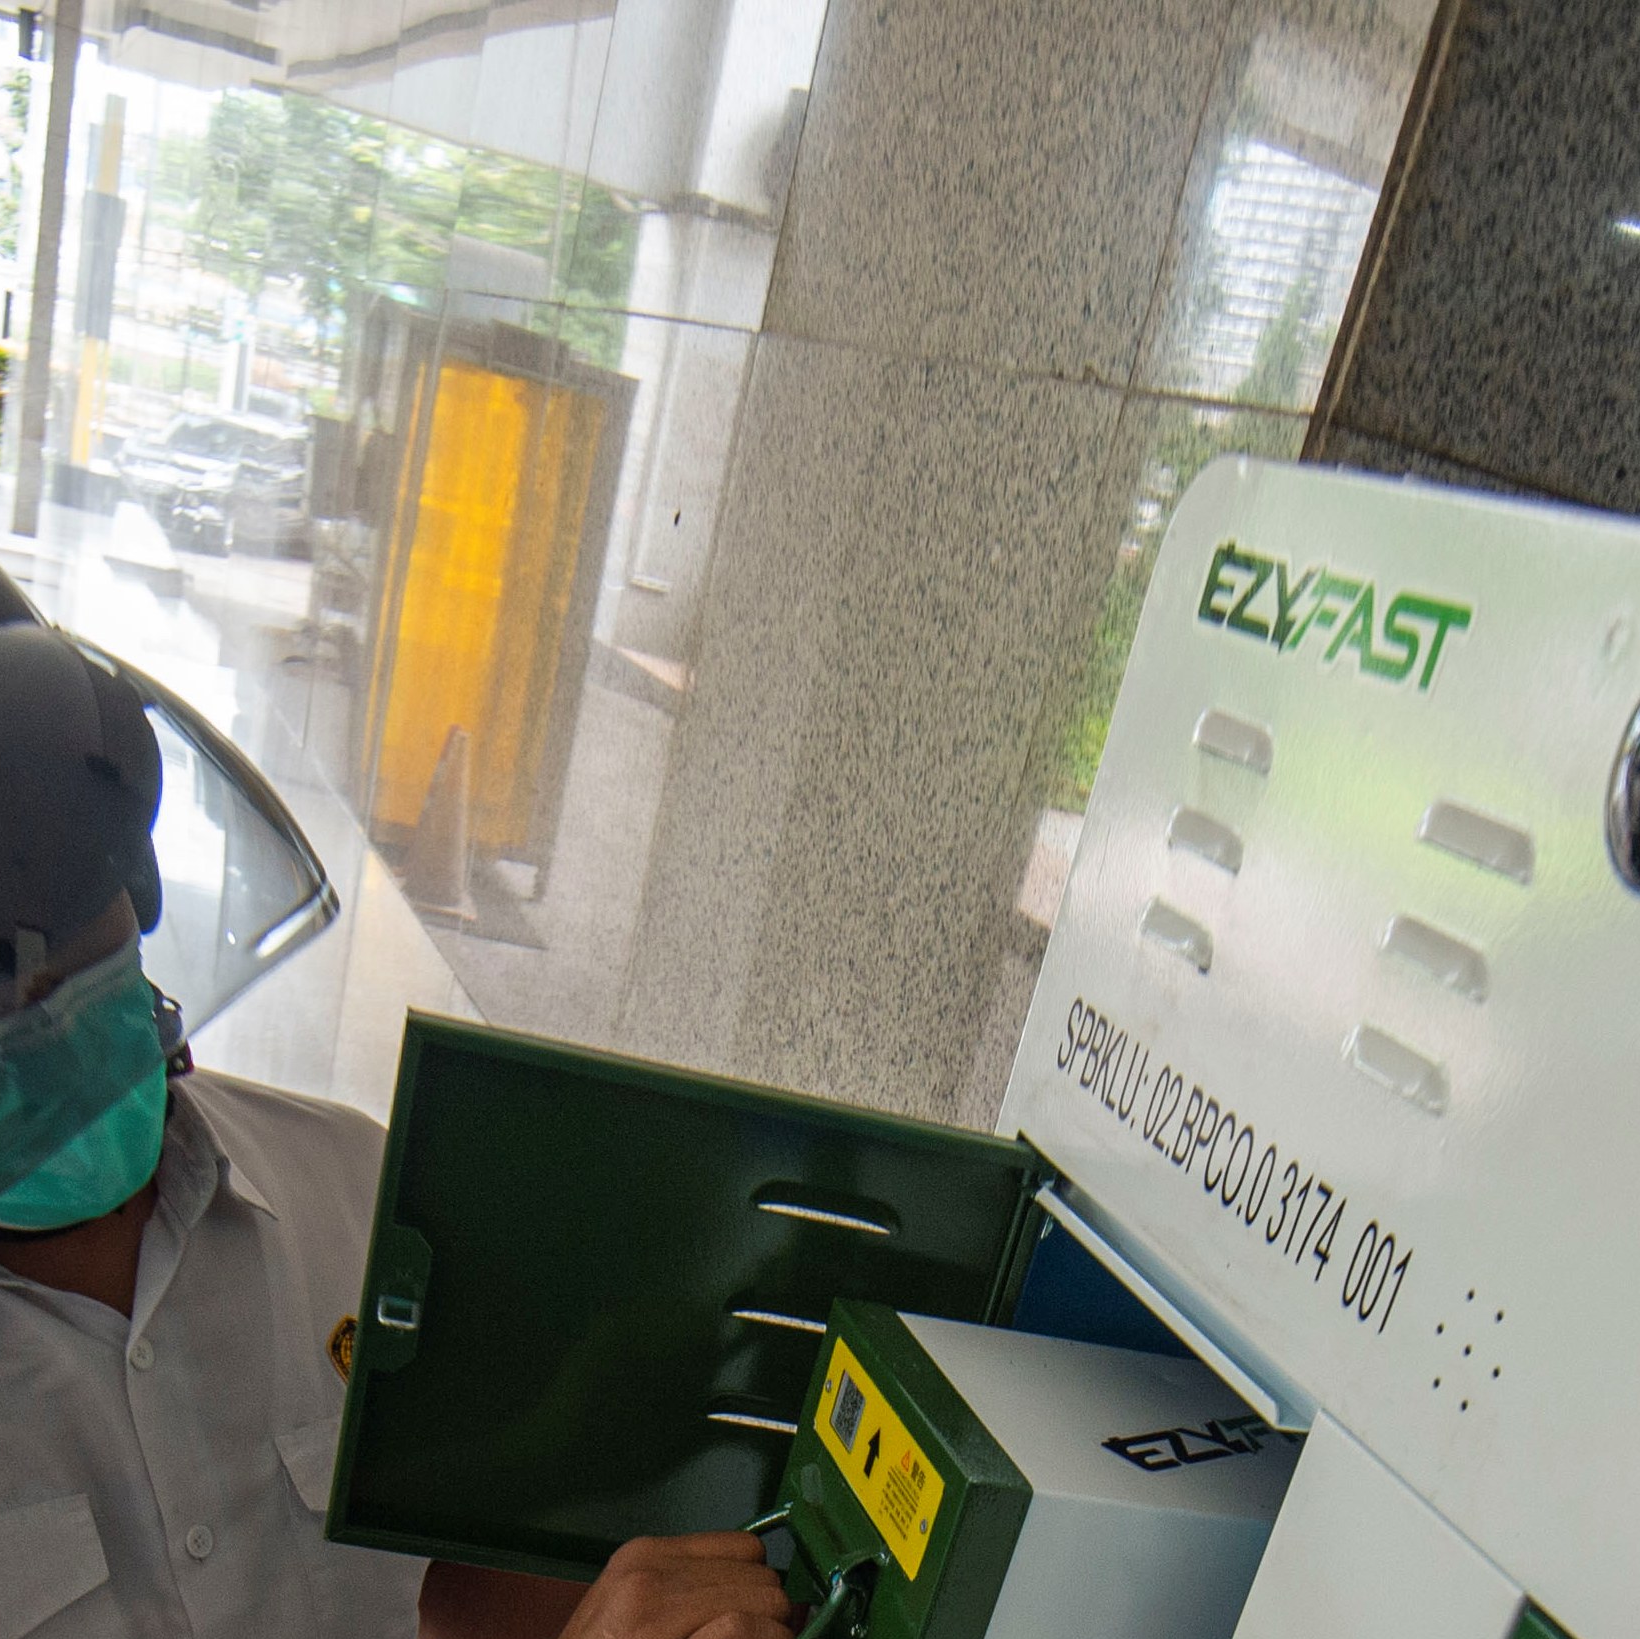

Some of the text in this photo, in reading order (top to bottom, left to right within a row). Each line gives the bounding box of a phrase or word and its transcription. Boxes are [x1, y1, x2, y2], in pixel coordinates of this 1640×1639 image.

[1196, 541, 1472, 692] EZYFAST
[1265, 1160, 1347, 1282] 3174
[1341, 1220, 1414, 1334] 001
